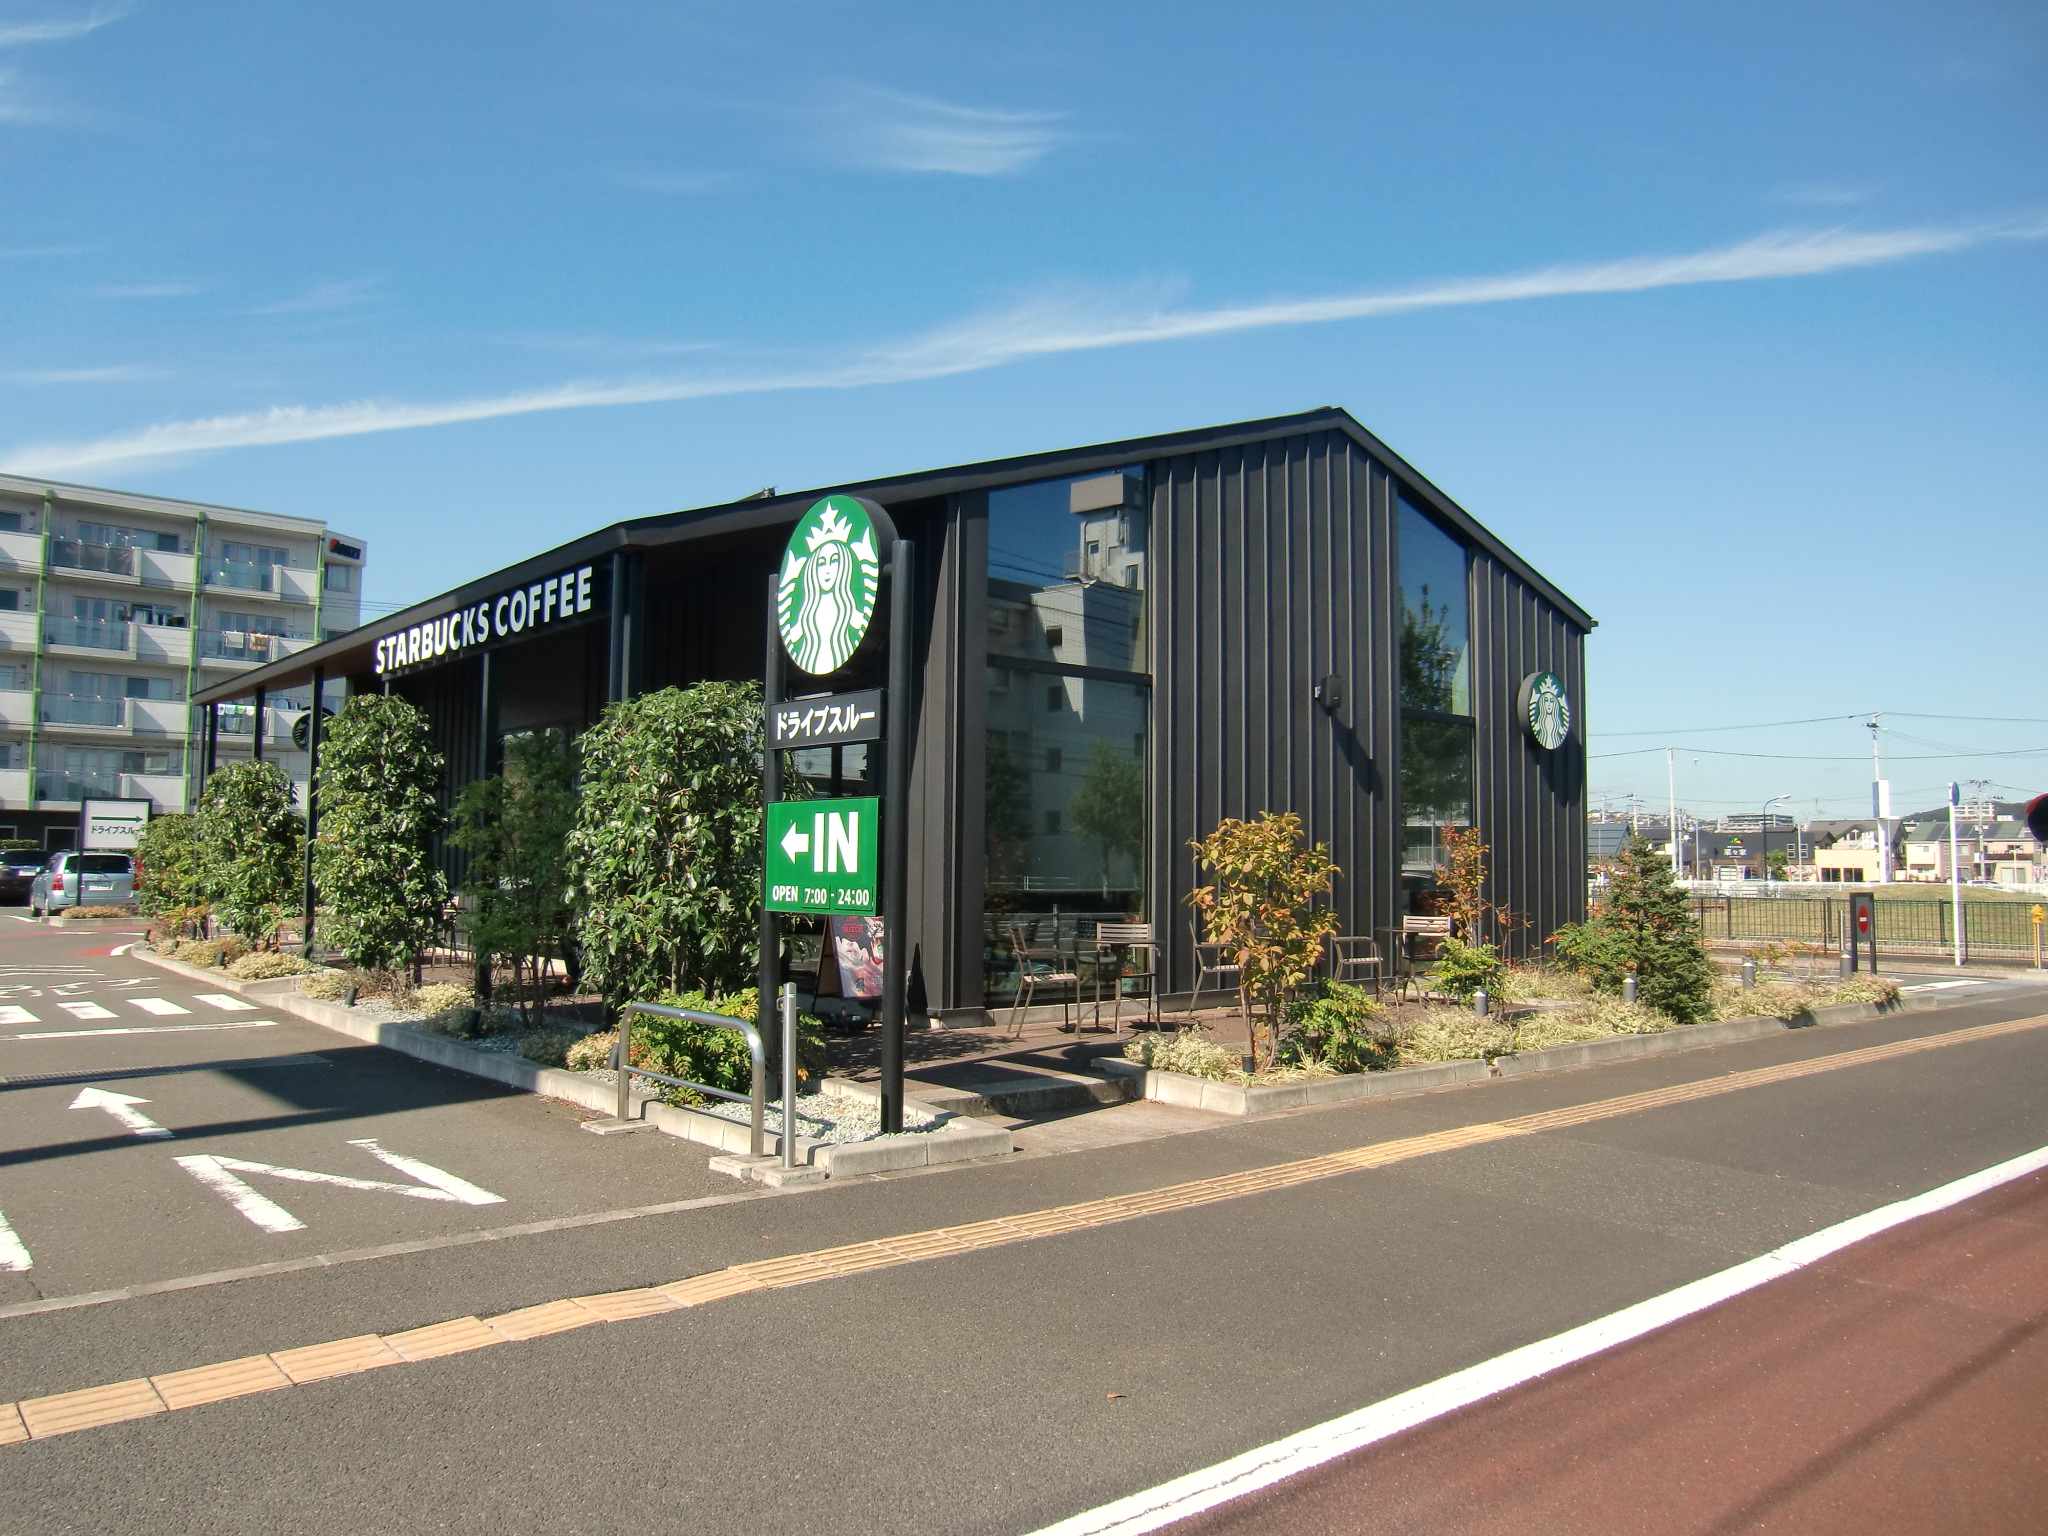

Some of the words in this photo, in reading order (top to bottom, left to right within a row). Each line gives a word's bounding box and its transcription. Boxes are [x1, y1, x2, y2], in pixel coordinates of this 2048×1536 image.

[375, 602, 490, 675] STARBUCKS
[495, 565, 593, 637] COFFEE
[777, 703, 876, 741] ドライブスルー
[813, 811, 859, 873] IN
[772, 885, 799, 902] OPEN
[804, 888, 827, 905] 7:00
[837, 888, 870, 906] 24:00
